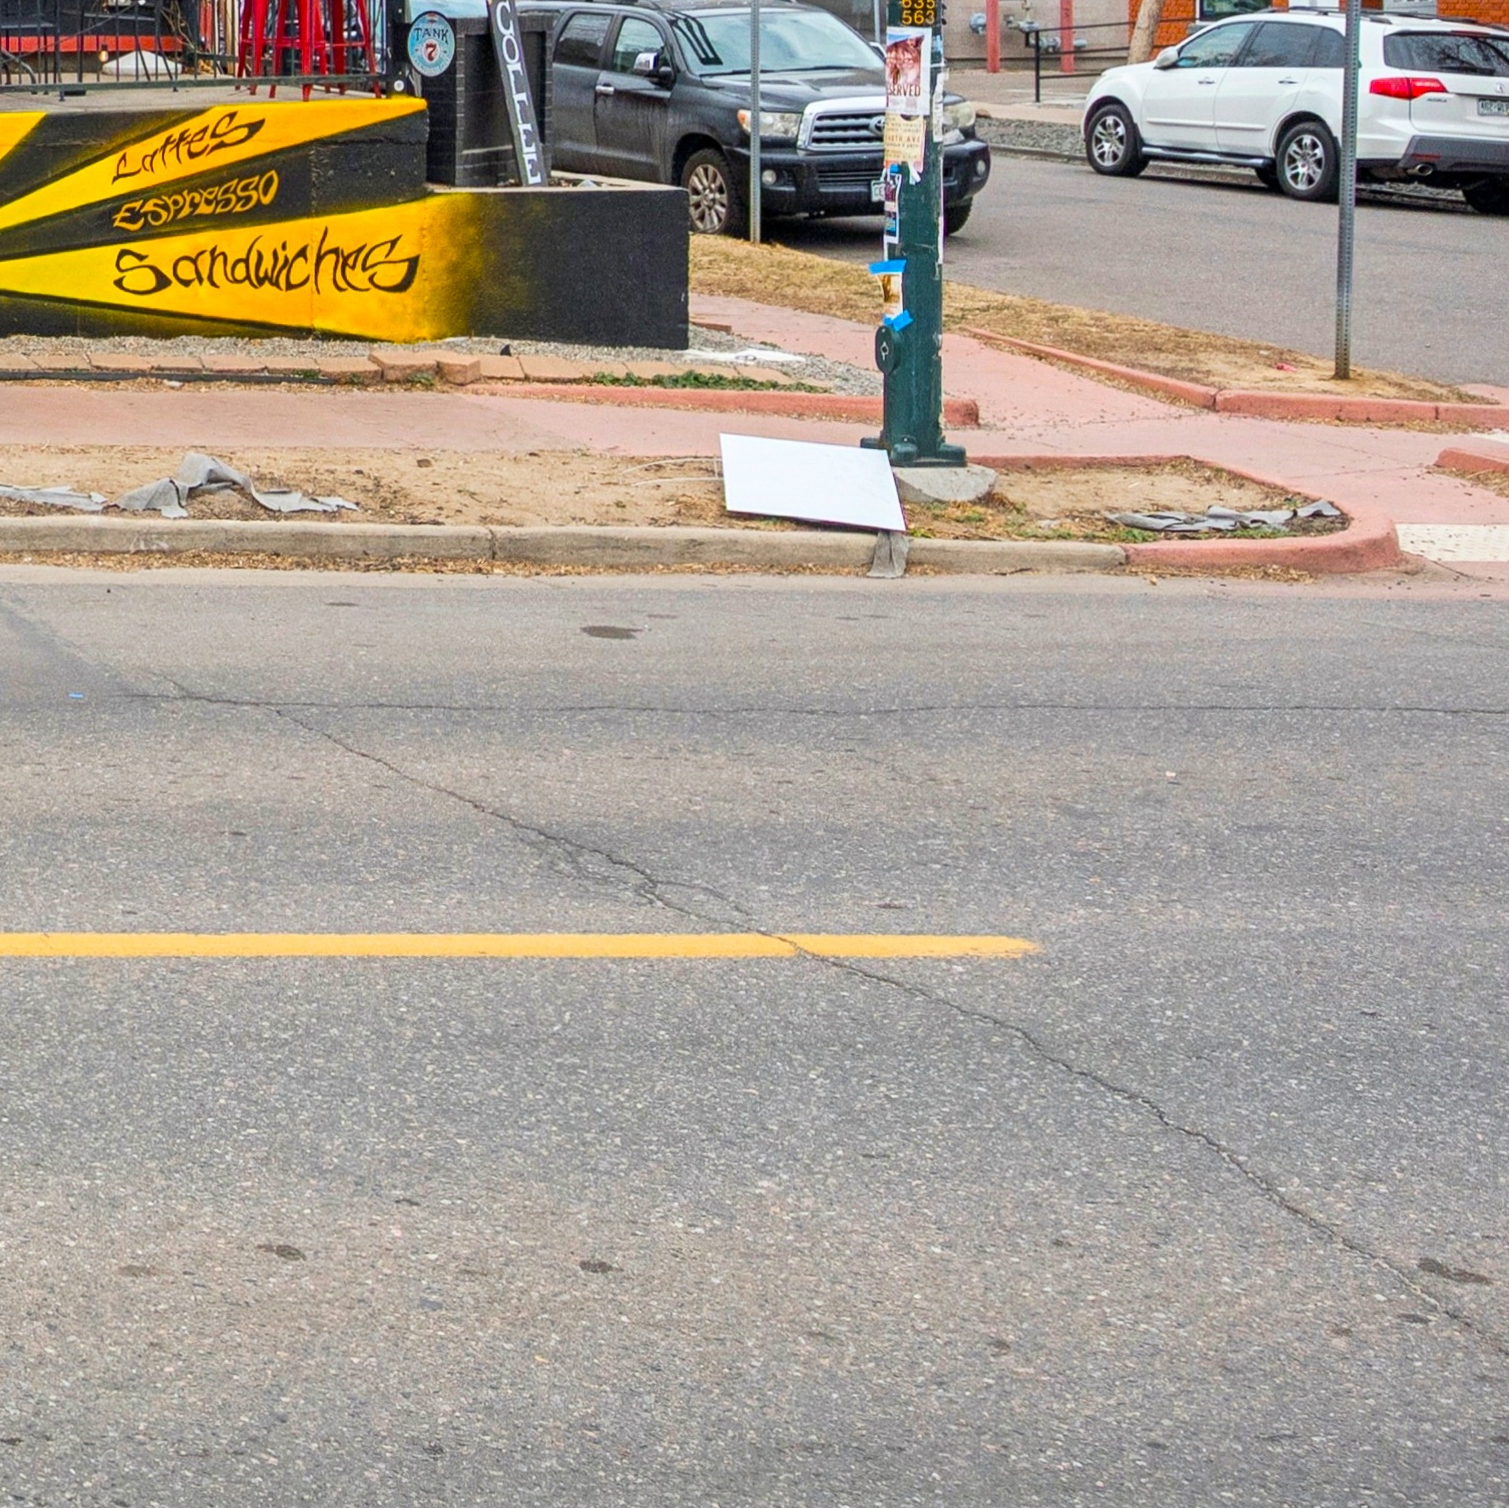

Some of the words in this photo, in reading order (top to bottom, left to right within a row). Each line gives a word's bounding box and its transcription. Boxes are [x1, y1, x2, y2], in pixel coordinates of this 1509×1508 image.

[902, 10, 935, 25] 563
[414, 27, 448, 45] TANK
[425, 43, 437, 62] 7
[111, 110, 266, 185] Lattes
[112, 225, 421, 295] Sandwiches
